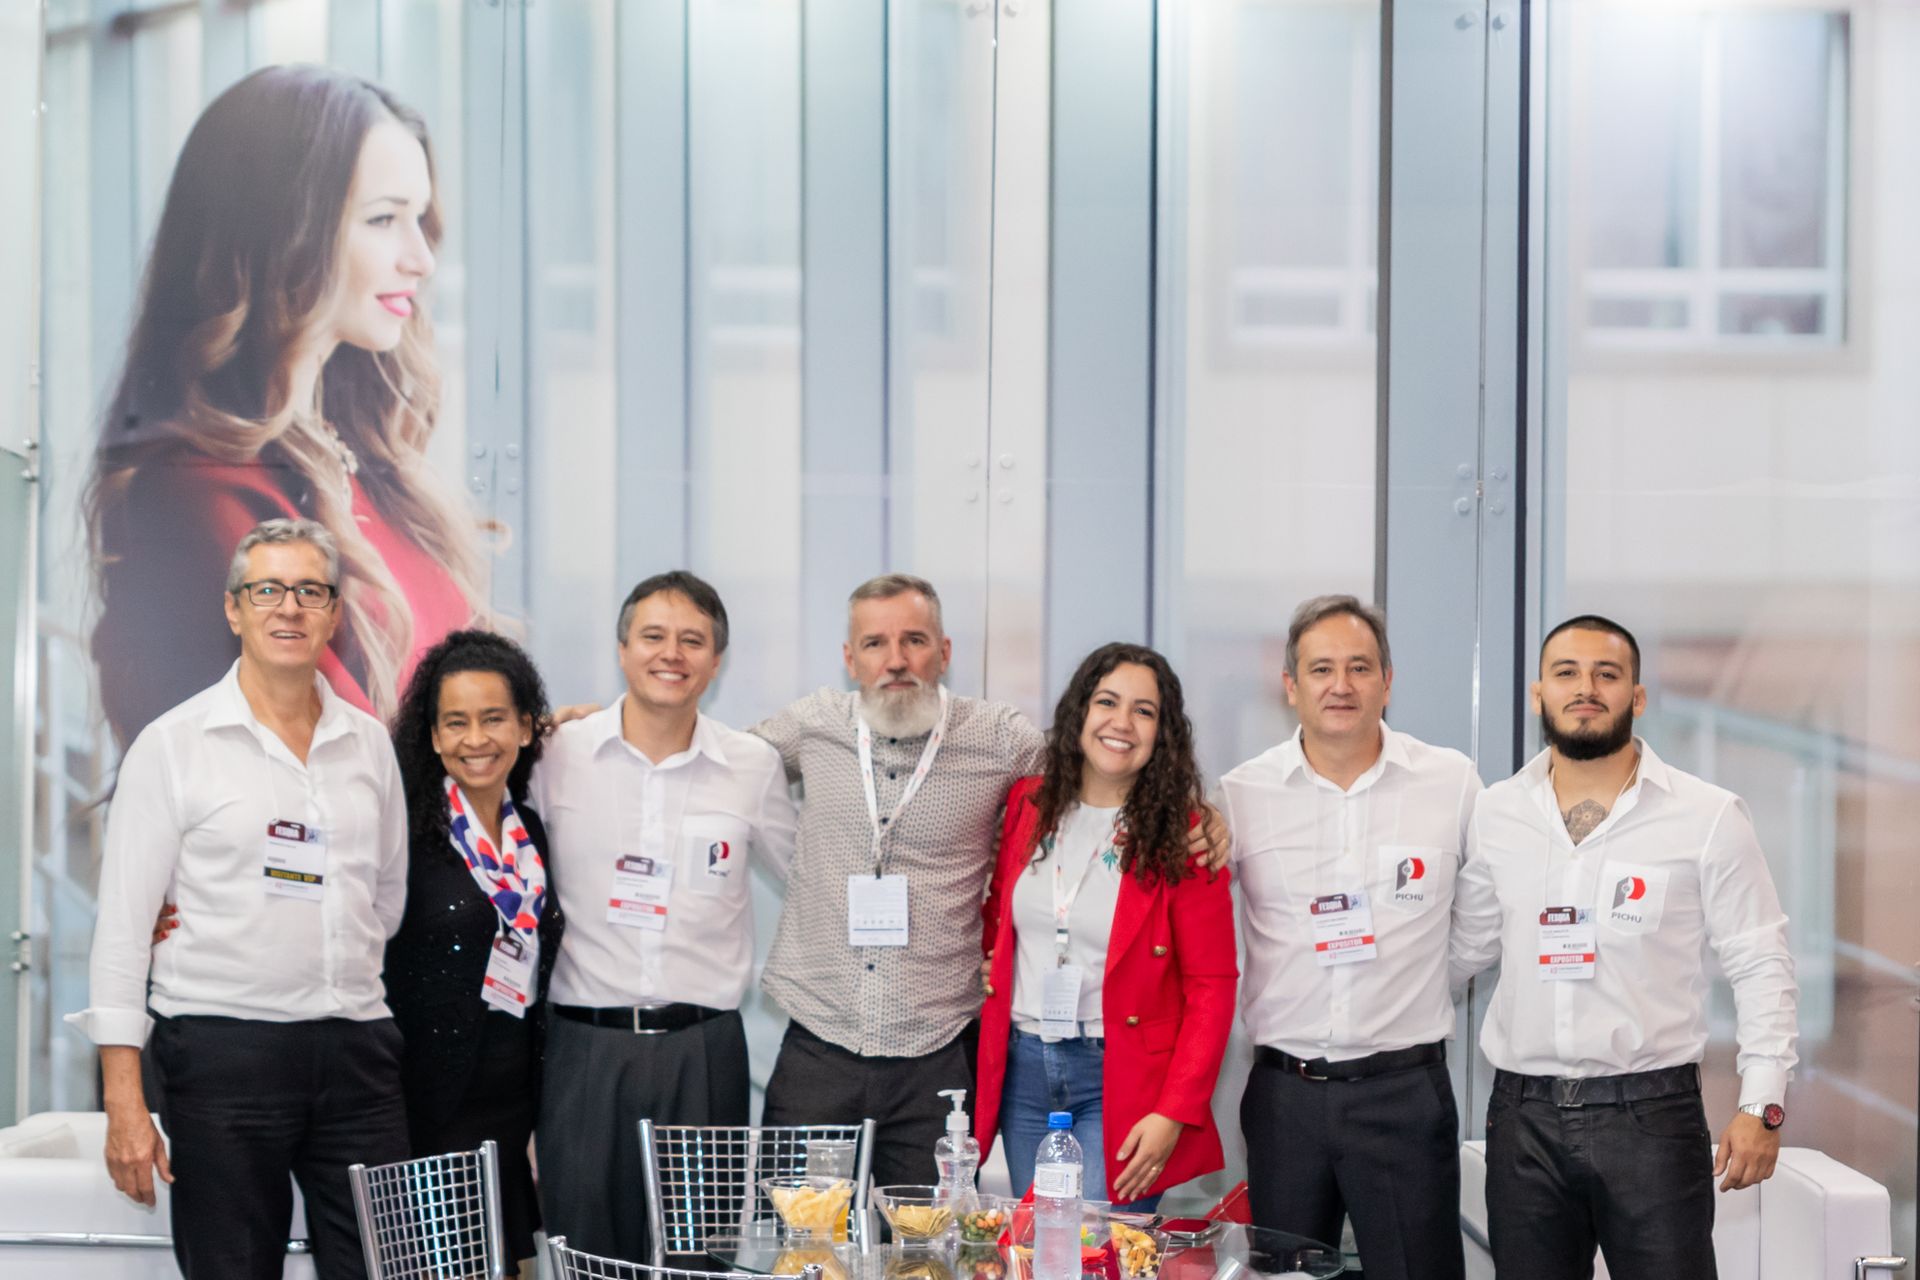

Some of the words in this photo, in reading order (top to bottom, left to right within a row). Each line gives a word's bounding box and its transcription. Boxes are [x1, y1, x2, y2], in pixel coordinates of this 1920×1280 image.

[1395, 893, 1424, 901] PICHU
[1611, 911, 1643, 923] PICHU
[1550, 954, 1584, 964] EXPOSITOR
